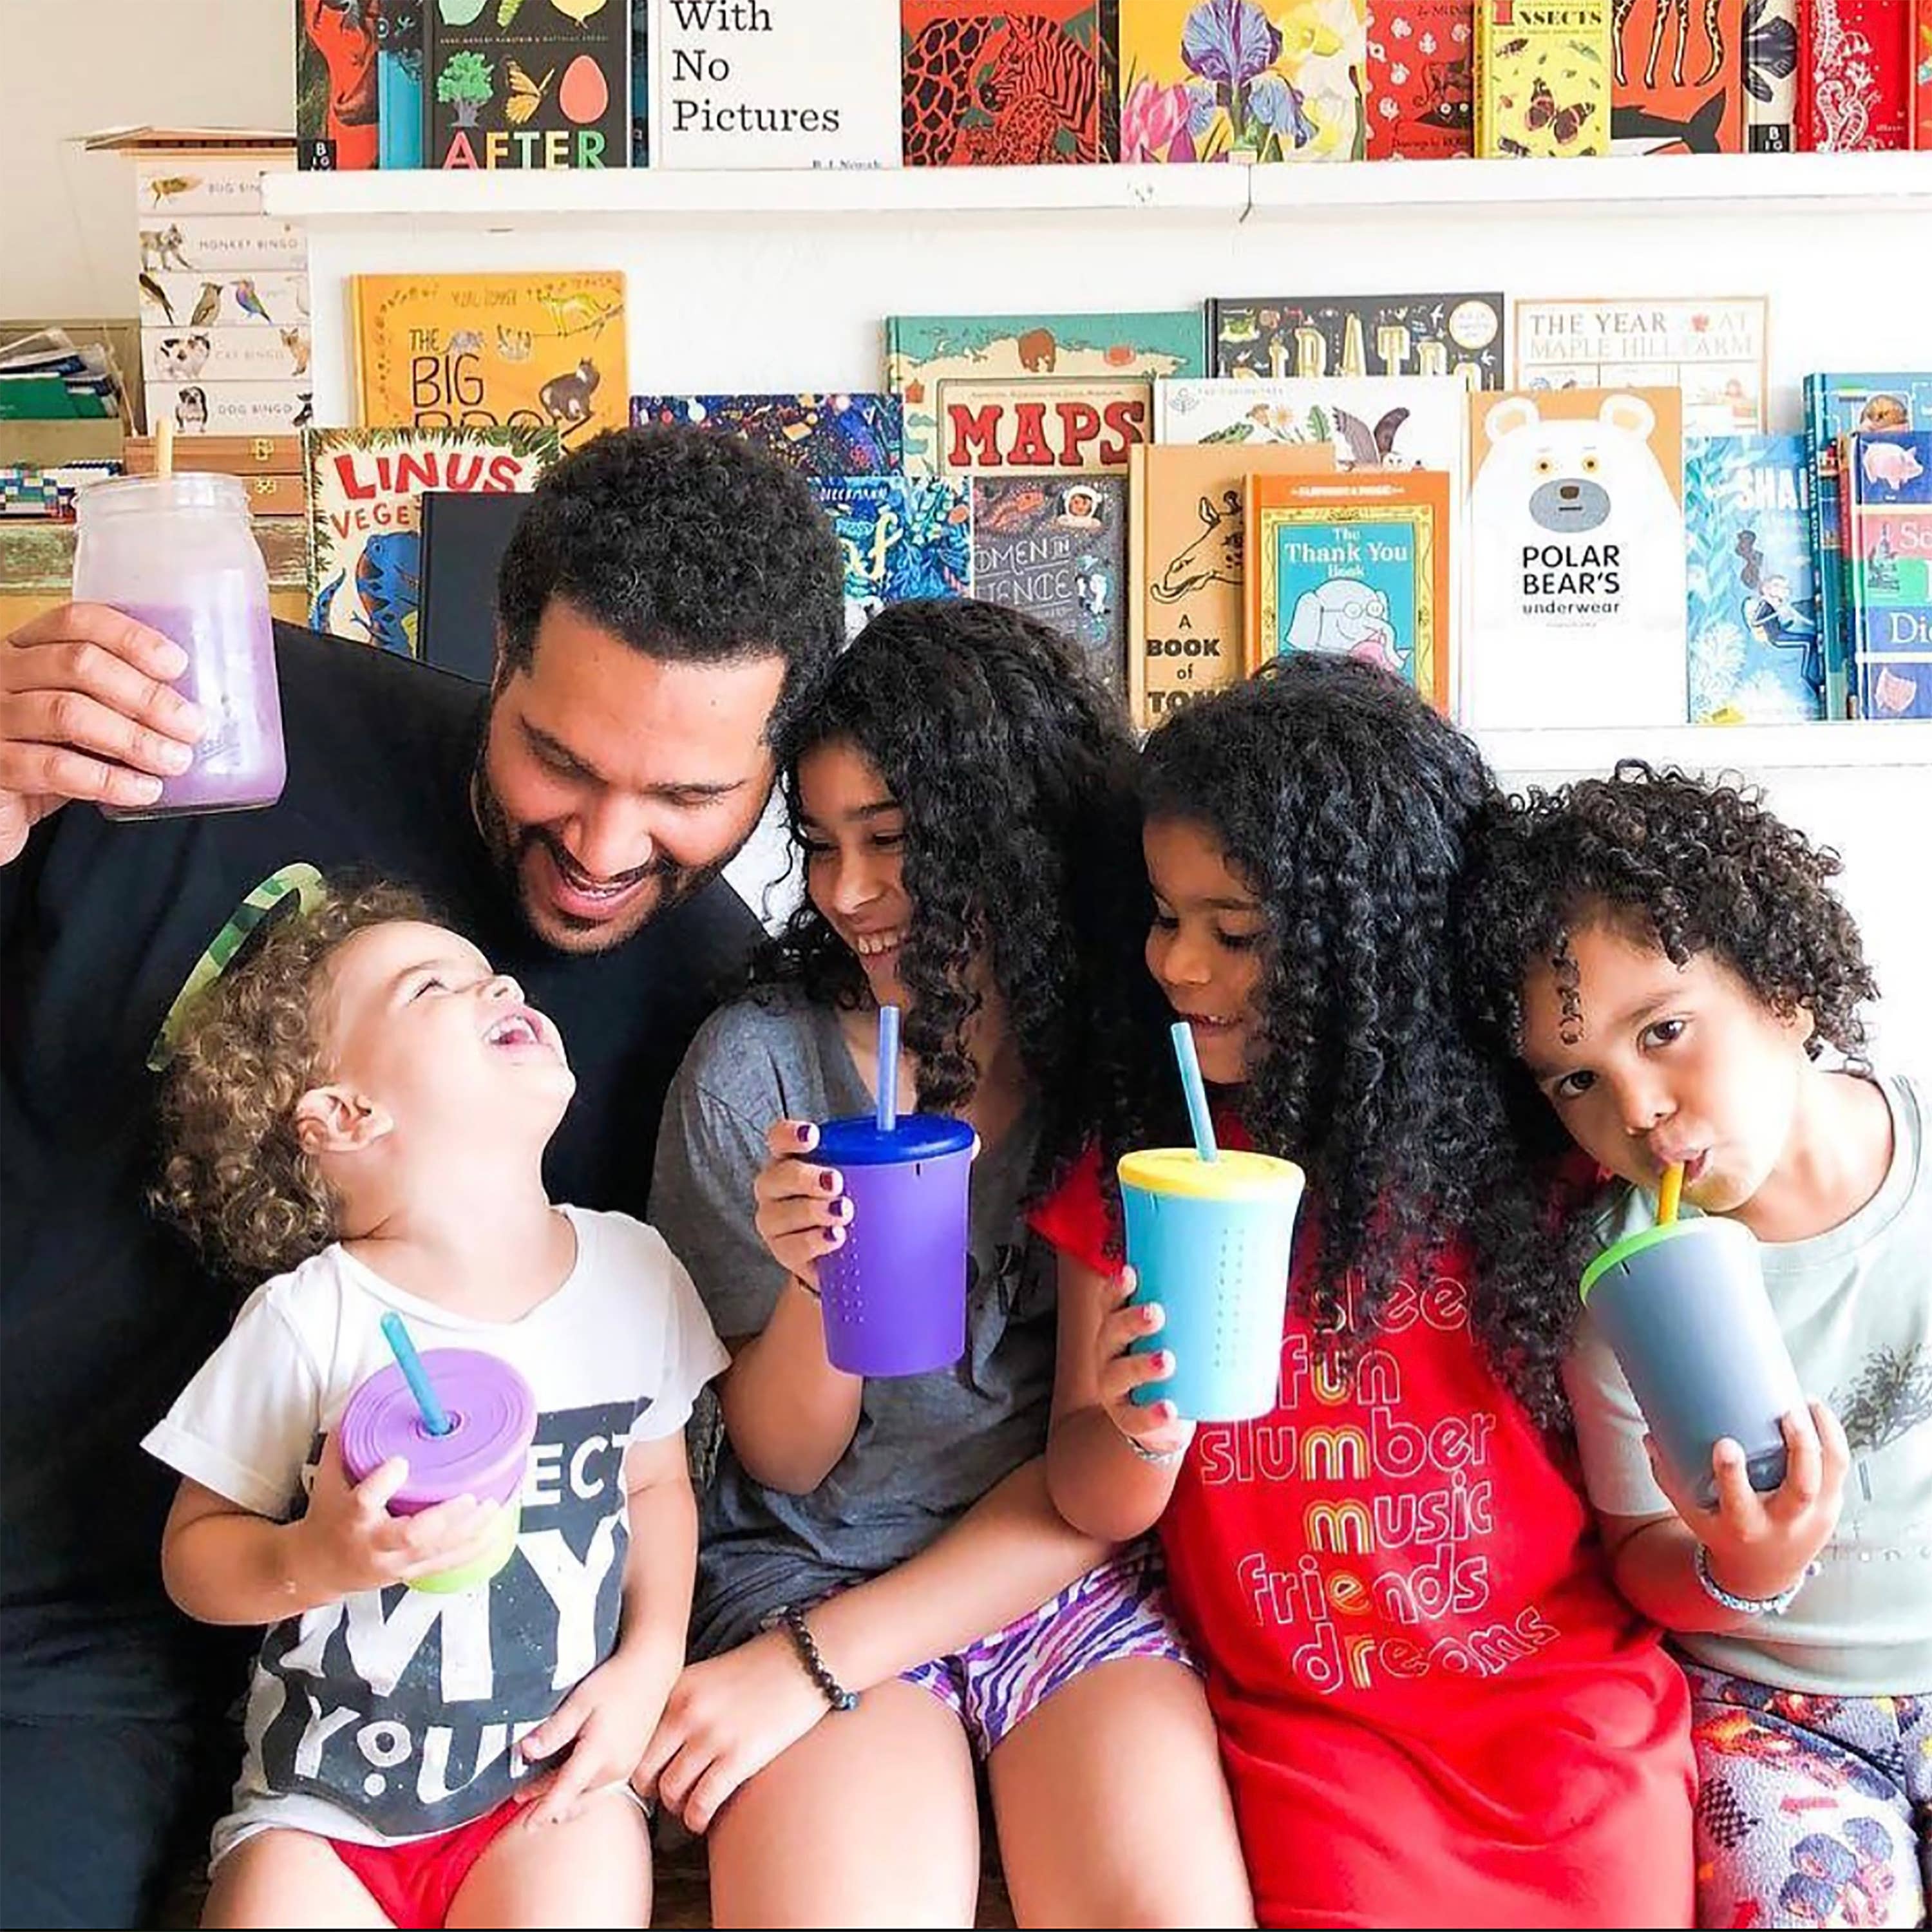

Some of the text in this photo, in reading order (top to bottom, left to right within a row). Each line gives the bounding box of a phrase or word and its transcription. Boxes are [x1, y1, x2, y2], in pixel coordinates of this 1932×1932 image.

[670, 0, 773, 31] With
[672, 49, 730, 81] No
[672, 99, 840, 132] Pictures
[443, 130, 606, 169] AFTER
[239, 182, 261, 193] BIN
[409, 327, 440, 351] THE
[1529, 312, 1748, 336] THE YEAR AT
[1531, 338, 1611, 359] MAPLE
[1622, 336, 1675, 357] HILL
[412, 352, 485, 408] BIG
[947, 400, 1145, 467] MAPS
[334, 452, 523, 500] LINUS
[331, 500, 421, 540] VEGE
[1333, 527, 1361, 541] The
[974, 540, 1048, 576] OMEN
[1285, 542, 1408, 563] Thank You
[1522, 545, 1620, 568] POLAR
[976, 570, 1073, 605] IENCE
[1327, 565, 1365, 578] Book
[1523, 572, 1620, 595] BEAR'S
[1179, 614, 1192, 629] A
[1522, 600, 1620, 614] underwear
[1889, 612, 1932, 644] Di
[1146, 638, 1221, 657] BOOK
[1177, 663, 1193, 680] of
[1314, 1269, 1477, 1343] slee
[1280, 1334, 1401, 1410] fun
[1200, 1405, 1497, 1484] slumber
[1305, 1470, 1494, 1555] music
[1237, 1542, 1490, 1627] friends
[279, 1510, 625, 1703] MY
[1293, 1605, 1561, 1695] dreams
